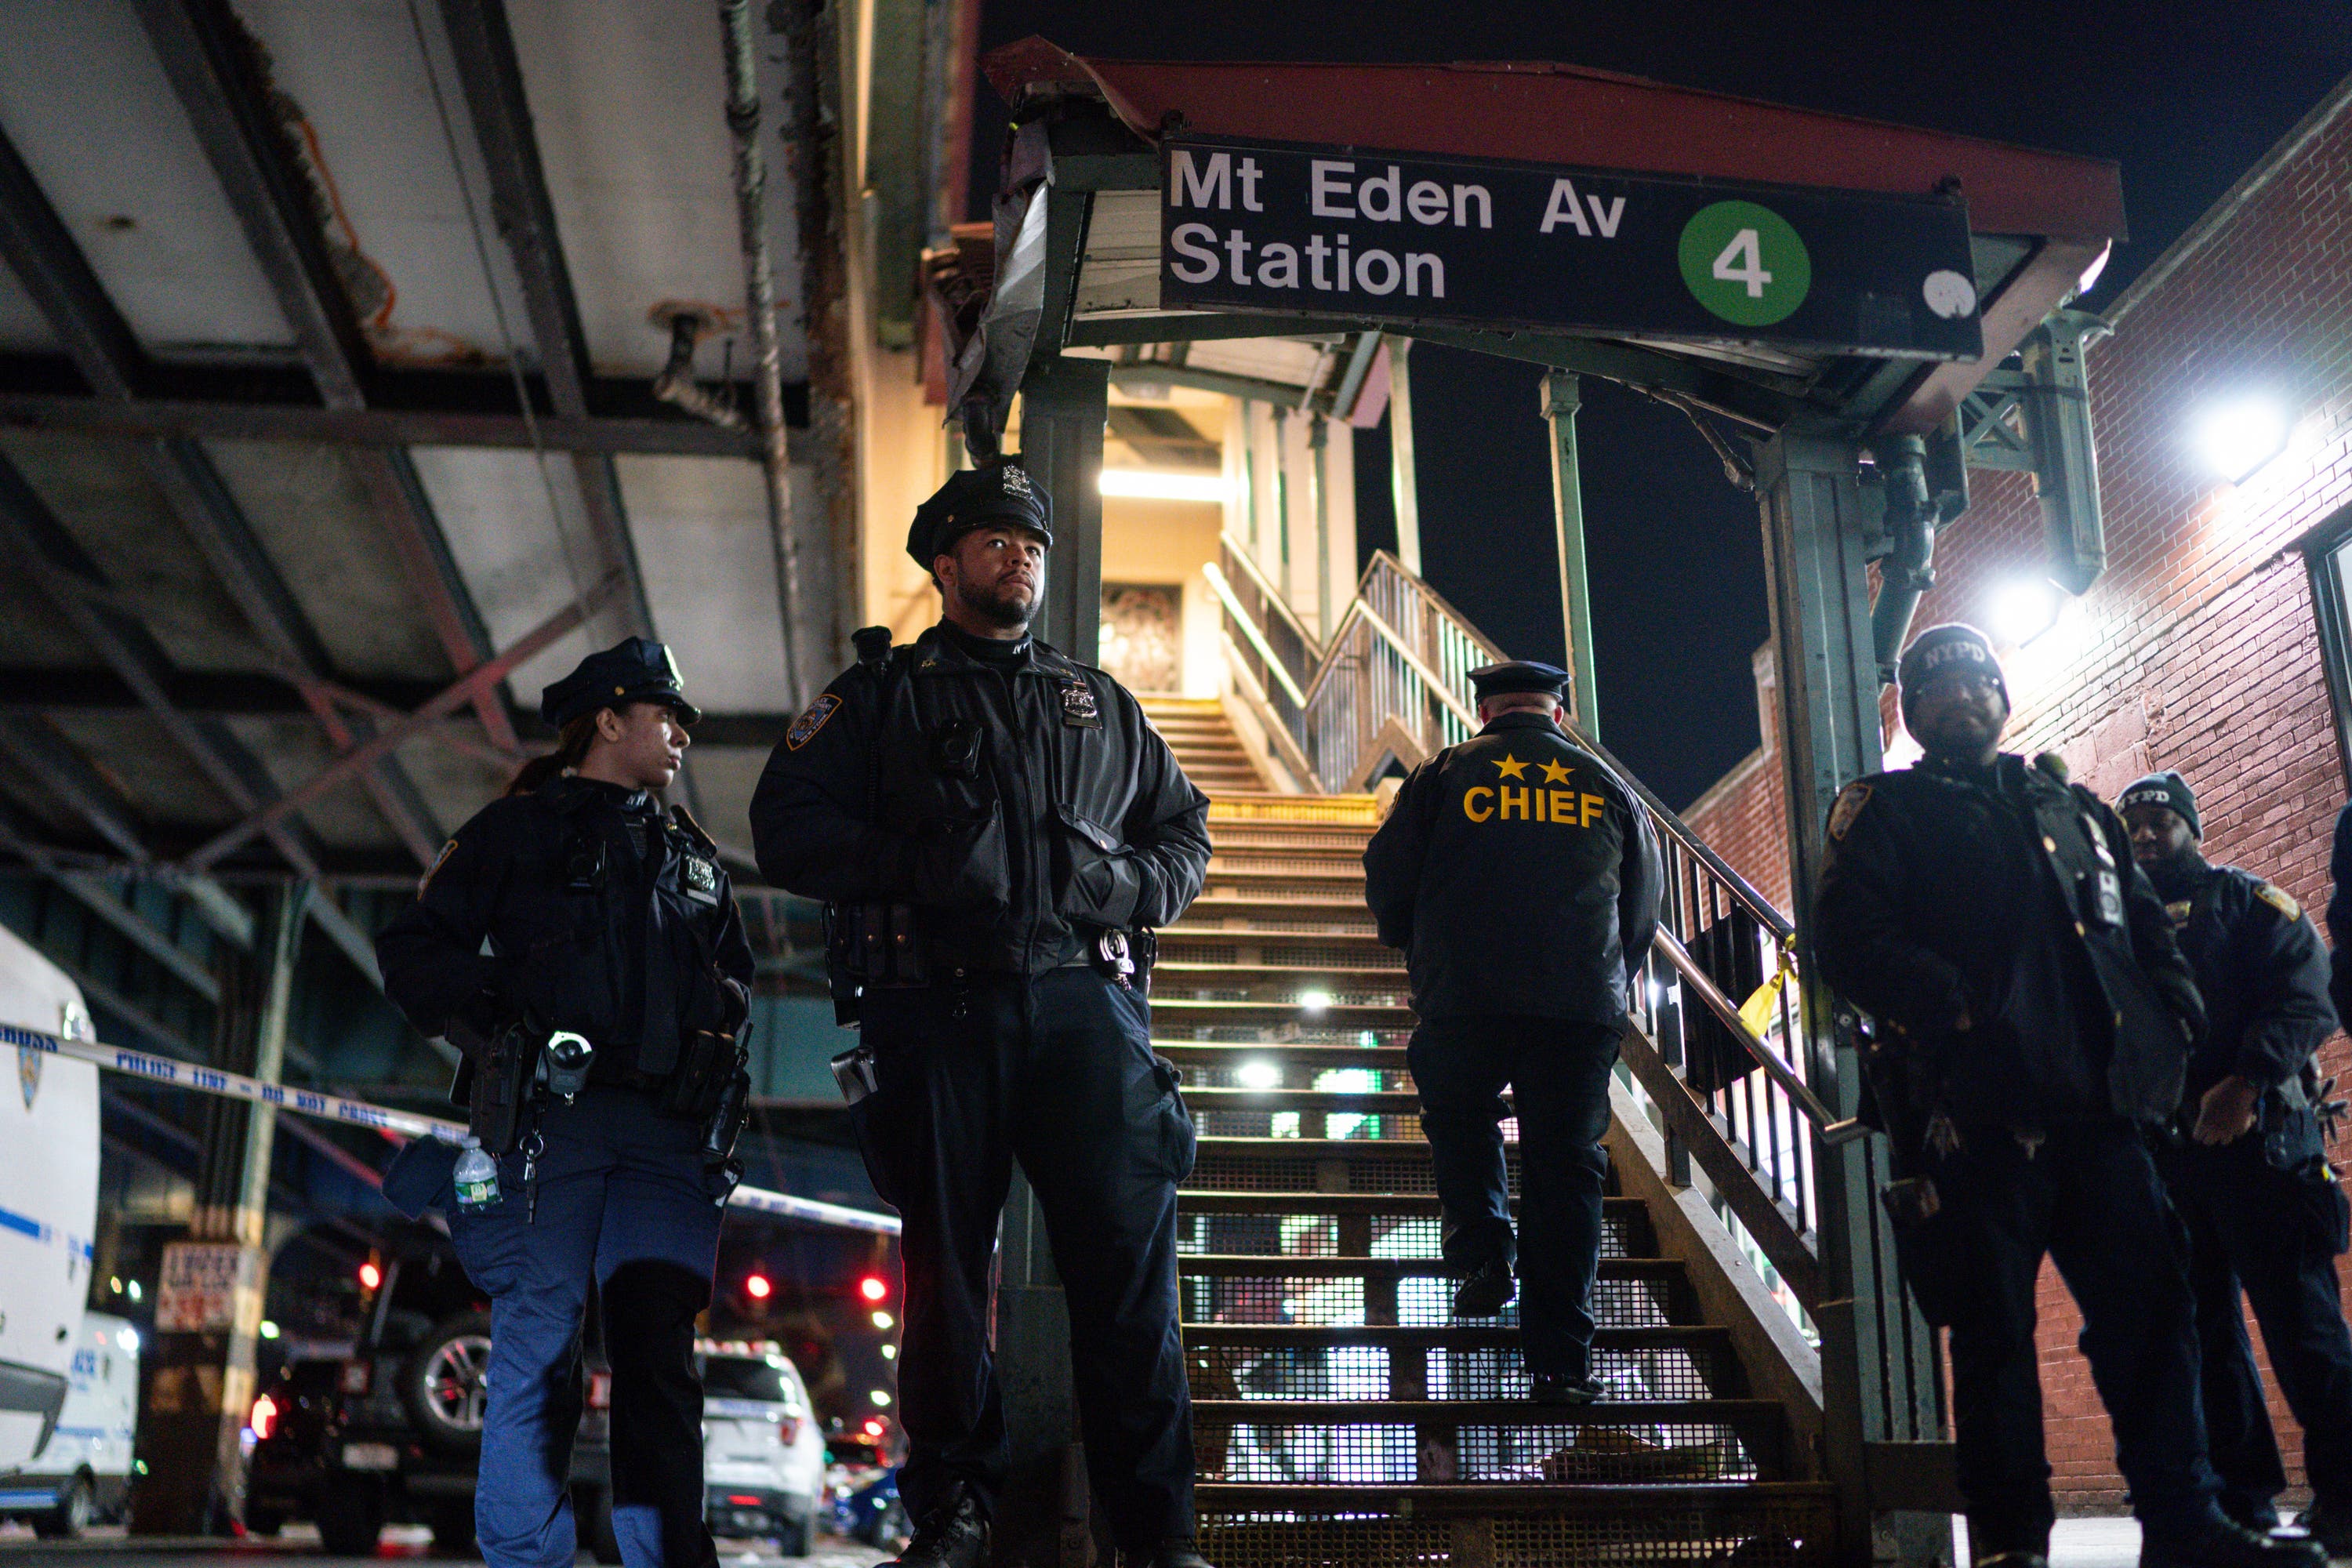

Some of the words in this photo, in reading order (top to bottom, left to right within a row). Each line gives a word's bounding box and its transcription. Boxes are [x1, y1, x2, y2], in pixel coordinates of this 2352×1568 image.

[1171, 151, 1264, 212] Mt
[1311, 159, 1493, 229] Eden
[1539, 179, 1626, 238] Av
[1171, 223, 1446, 298] Station
[1712, 229, 1772, 298] 4
[1925, 641, 1986, 669] NYPD
[1463, 785, 1605, 829] CHIEF
